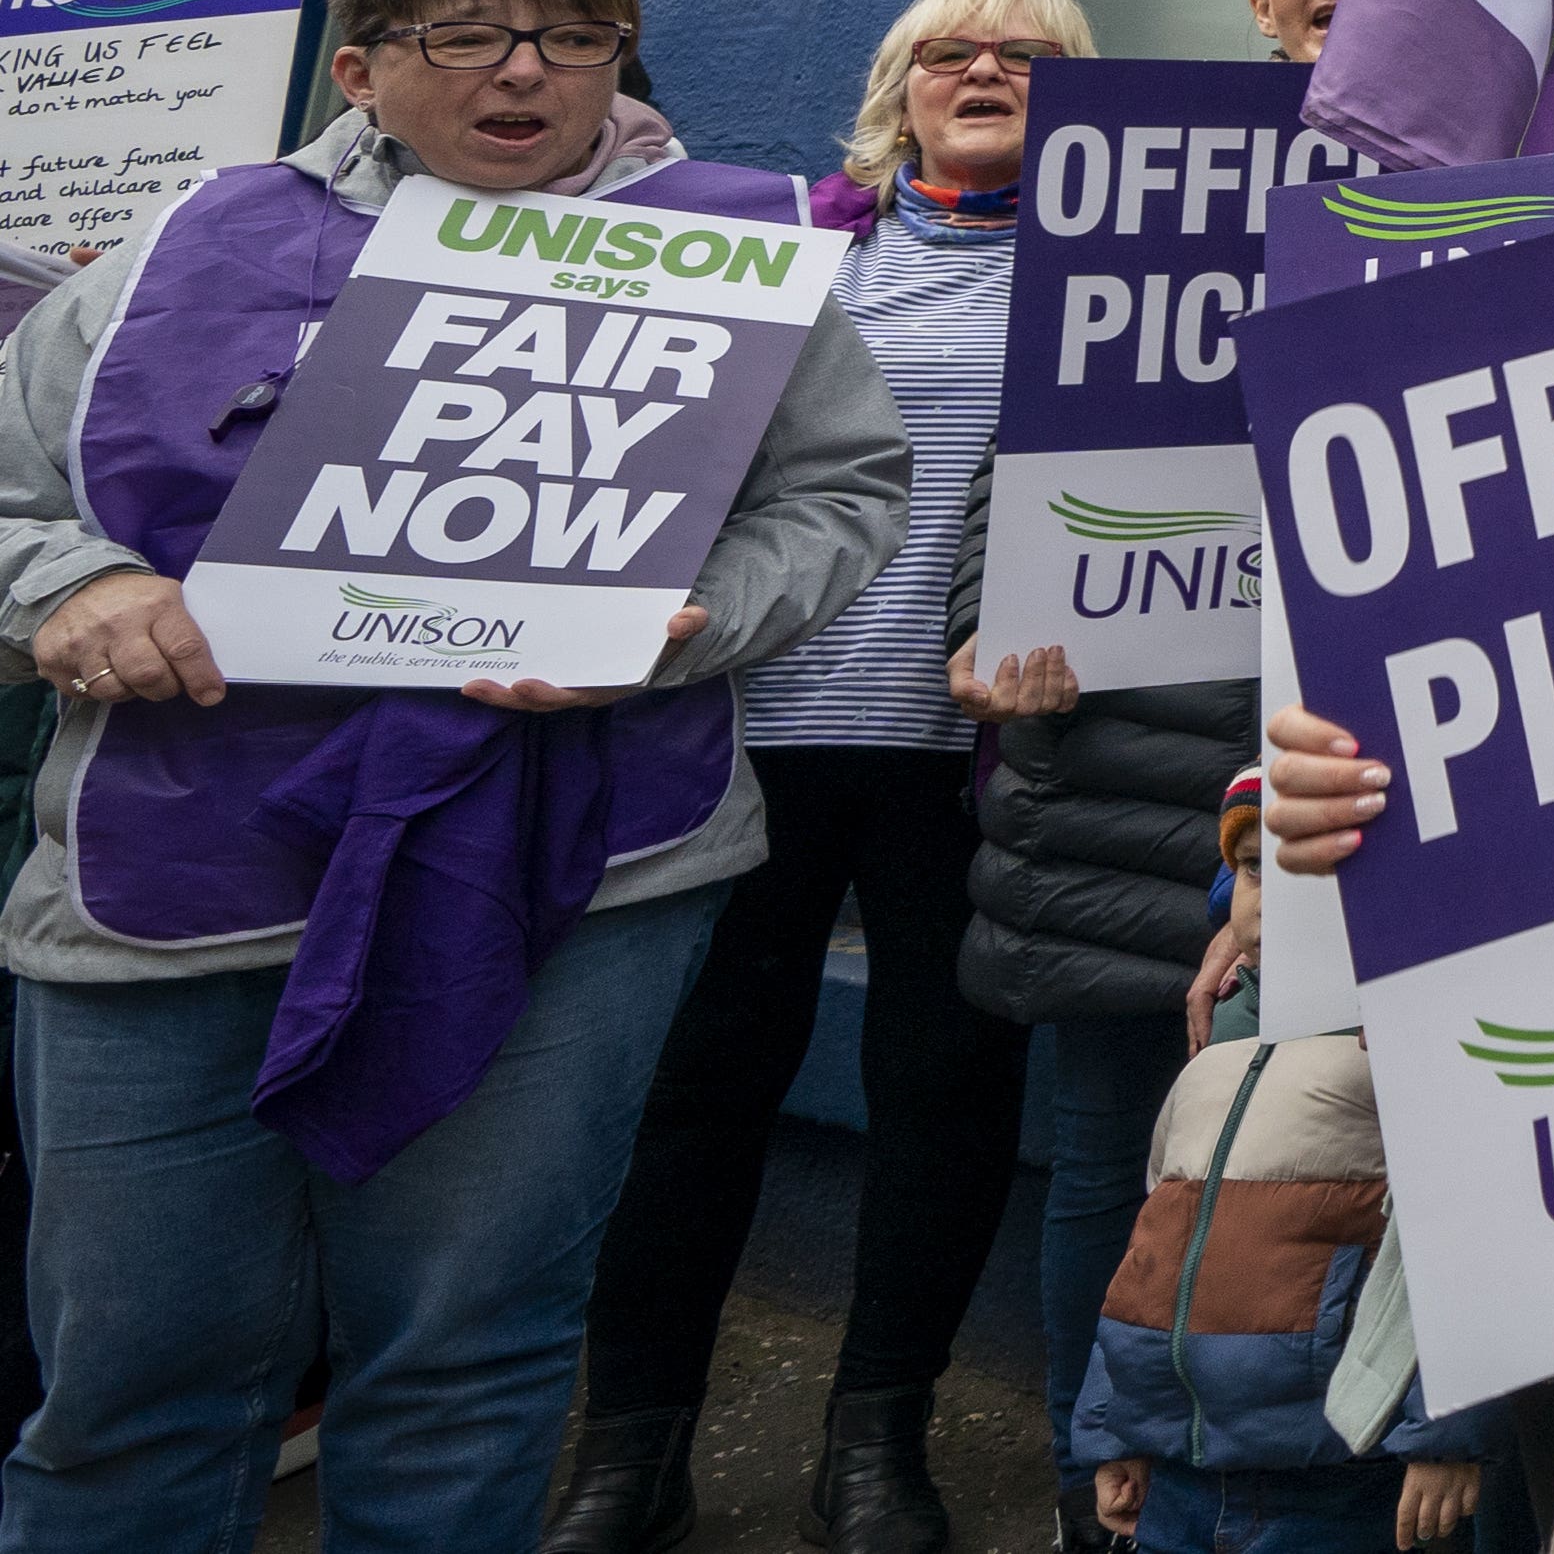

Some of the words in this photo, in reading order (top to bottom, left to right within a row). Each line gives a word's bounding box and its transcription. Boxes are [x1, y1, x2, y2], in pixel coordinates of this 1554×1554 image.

[85, 40, 122, 63] US
[138, 32, 222, 59] FEEL
[18, 66, 124, 93] VALUED
[8, 96, 79, 116] don't
[85, 88, 164, 109] match
[168, 85, 224, 111] your
[18, 155, 110, 180] future
[115, 146, 204, 176] funded
[59, 180, 162, 197] childcare
[69, 207, 133, 231] offers
[437, 200, 799, 287] UNISON
[550, 271, 650, 298] says
[384, 291, 732, 399] FAIR
[378, 379, 684, 480] PAY
[279, 463, 687, 572] NOW
[332, 611, 525, 648] UNISON
[318, 650, 347, 663] the
[348, 651, 403, 667] public
[406, 656, 465, 669] service
[469, 658, 520, 670] union
